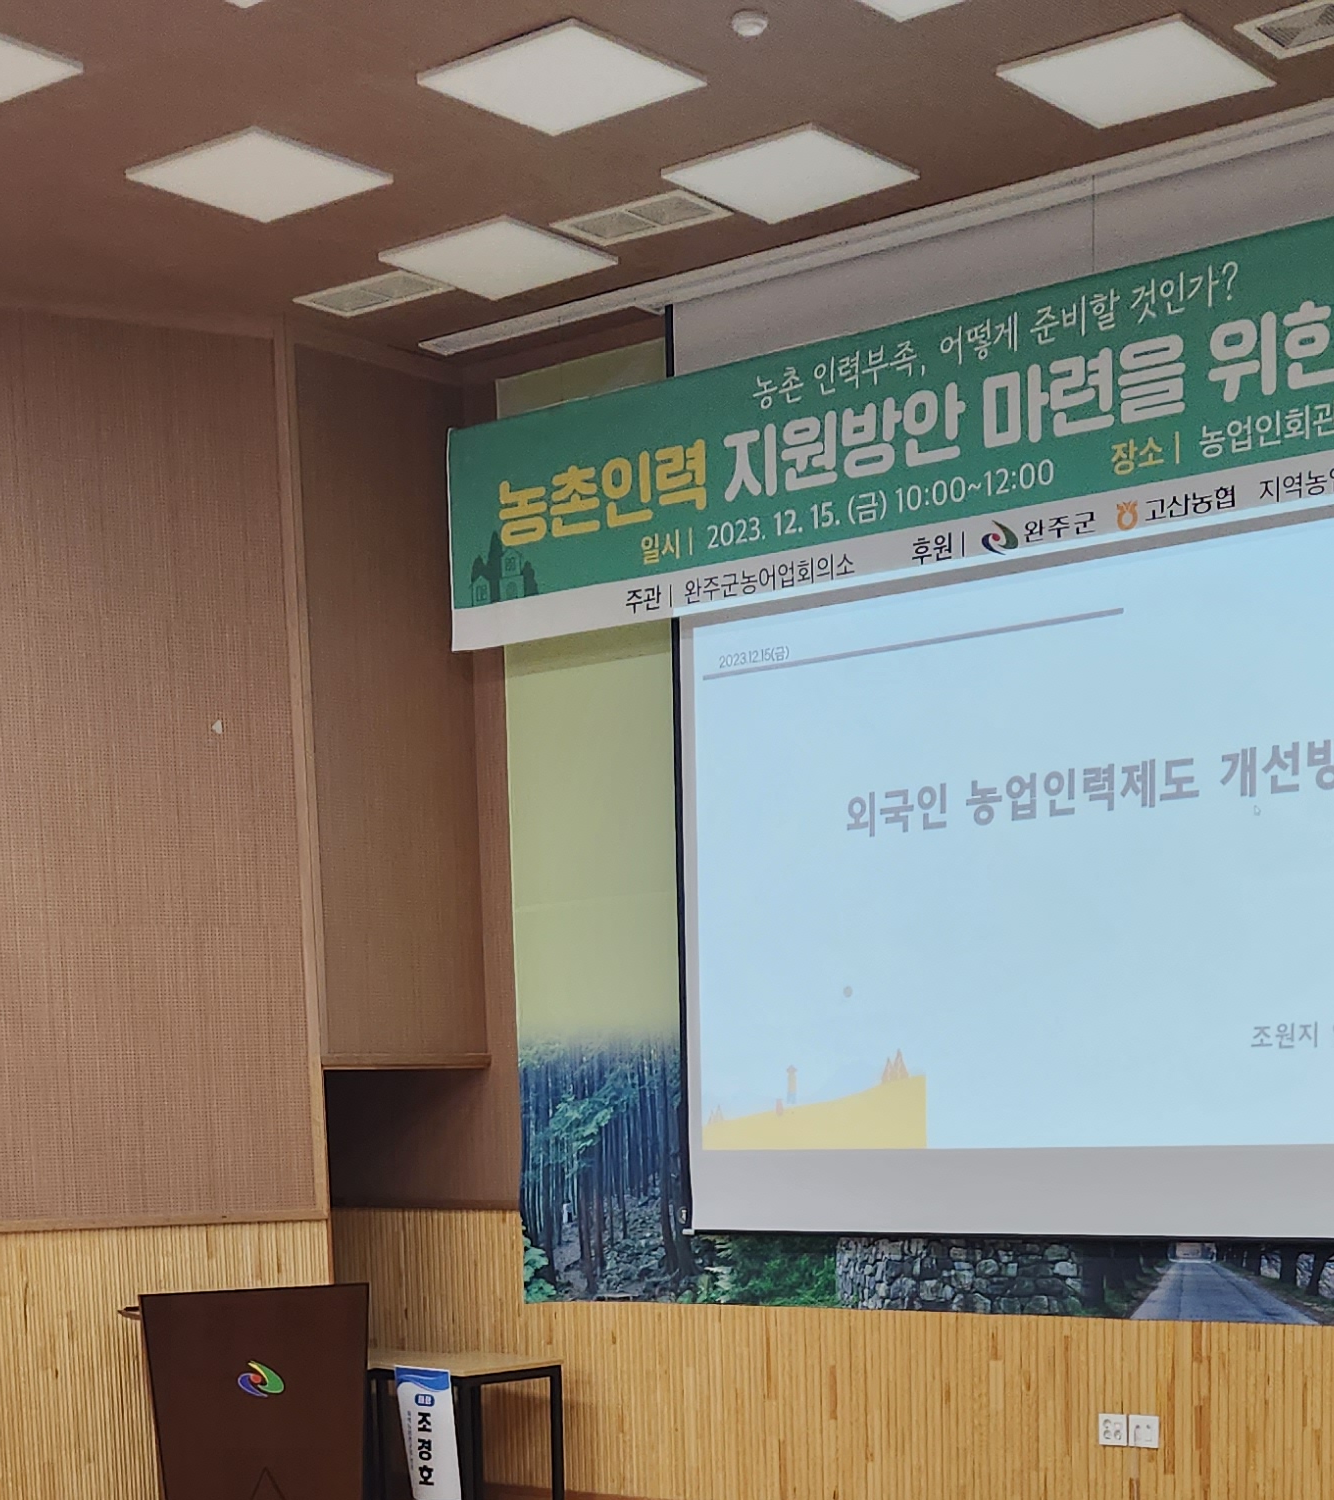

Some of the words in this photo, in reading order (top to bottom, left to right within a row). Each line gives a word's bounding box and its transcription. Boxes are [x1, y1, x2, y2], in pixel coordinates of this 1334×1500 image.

[752, 366, 804, 410] 농촌
[813, 339, 927, 396] 인력부족,
[940, 312, 1019, 366] 어떻게
[1029, 287, 1120, 347] 준비할
[1131, 261, 1239, 324] 것인가?
[498, 438, 708, 548] 농촌인력
[724, 385, 966, 502] 지원방안
[982, 335, 1186, 450] 마련을
[1110, 440, 1164, 477] 장소
[640, 533, 682, 566] 일시
[706, 517, 766, 551] 2023.
[773, 510, 804, 537] 12.
[810, 501, 842, 529] 15.
[846, 488, 887, 527] (금)
[895, 458, 1055, 512] 10:00~12:00
[911, 530, 954, 565] 후원
[1023, 510, 1097, 544] 완주군
[1144, 484, 1238, 523] 고산농협
[625, 586, 662, 615] 주관
[684, 552, 856, 606] 완주군농어업회의소
[845, 782, 948, 838] 외국인
[965, 756, 1201, 827] 농업인력제도
[1250, 1020, 1320, 1049] 조원지
